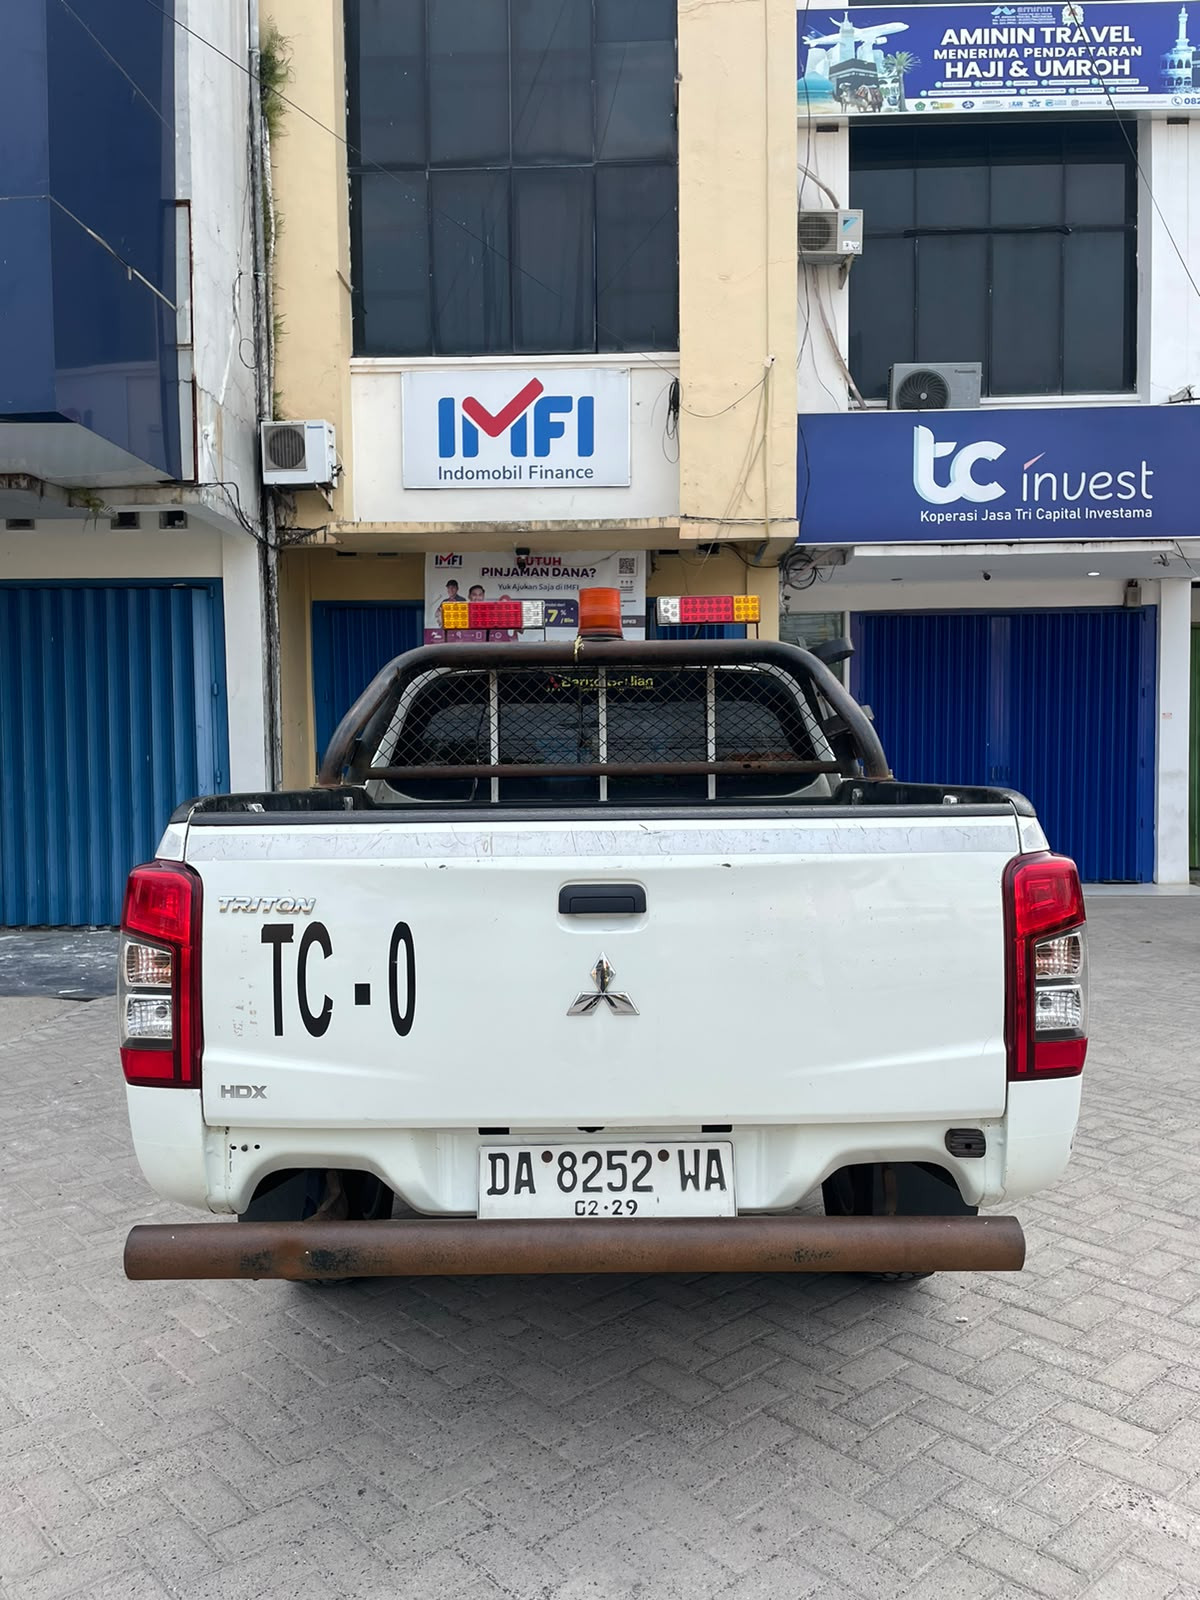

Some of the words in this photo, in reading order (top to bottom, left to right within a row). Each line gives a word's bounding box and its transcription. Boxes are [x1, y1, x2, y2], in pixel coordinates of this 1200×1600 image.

[940, 26, 1035, 46] AMININ
[1040, 25, 1136, 44] TRAVEL
[933, 47, 1020, 60] MENERIMA
[1024, 45, 1142, 58] PENDAFTARAN
[945, 60, 1004, 79] HAJI
[1008, 59, 1030, 77] &
[1034, 58, 1131, 77] UMROH
[438, 377, 594, 459] IMFI
[438, 465, 522, 481] Indomobil
[528, 465, 594, 480] Finance
[913, 424, 1007, 505] tc
[1022, 452, 1154, 502] invest
[920, 509, 978, 525] Koperasi
[981, 508, 1012, 522] Jasa
[1015, 508, 1032, 521] Tri
[1036, 507, 1081, 523] Capital
[1085, 507, 1153, 520] Investama
[435, 552, 462, 566] IMFI
[481, 567, 549, 577] PINJAMAN
[552, 567, 597, 578] DANA?
[497, 583, 511, 591] Yuk
[512, 583, 538, 592] Ajukan
[539, 583, 555, 592] Saja
[555, 583, 563, 591] di
[217, 896, 317, 915] TRITON
[260, 921, 334, 1038] TC
[220, 1084, 268, 1100] HDX
[486, 1151, 537, 1196] DA
[556, 1149, 654, 1194] 8252
[677, 1148, 728, 1193] WA
